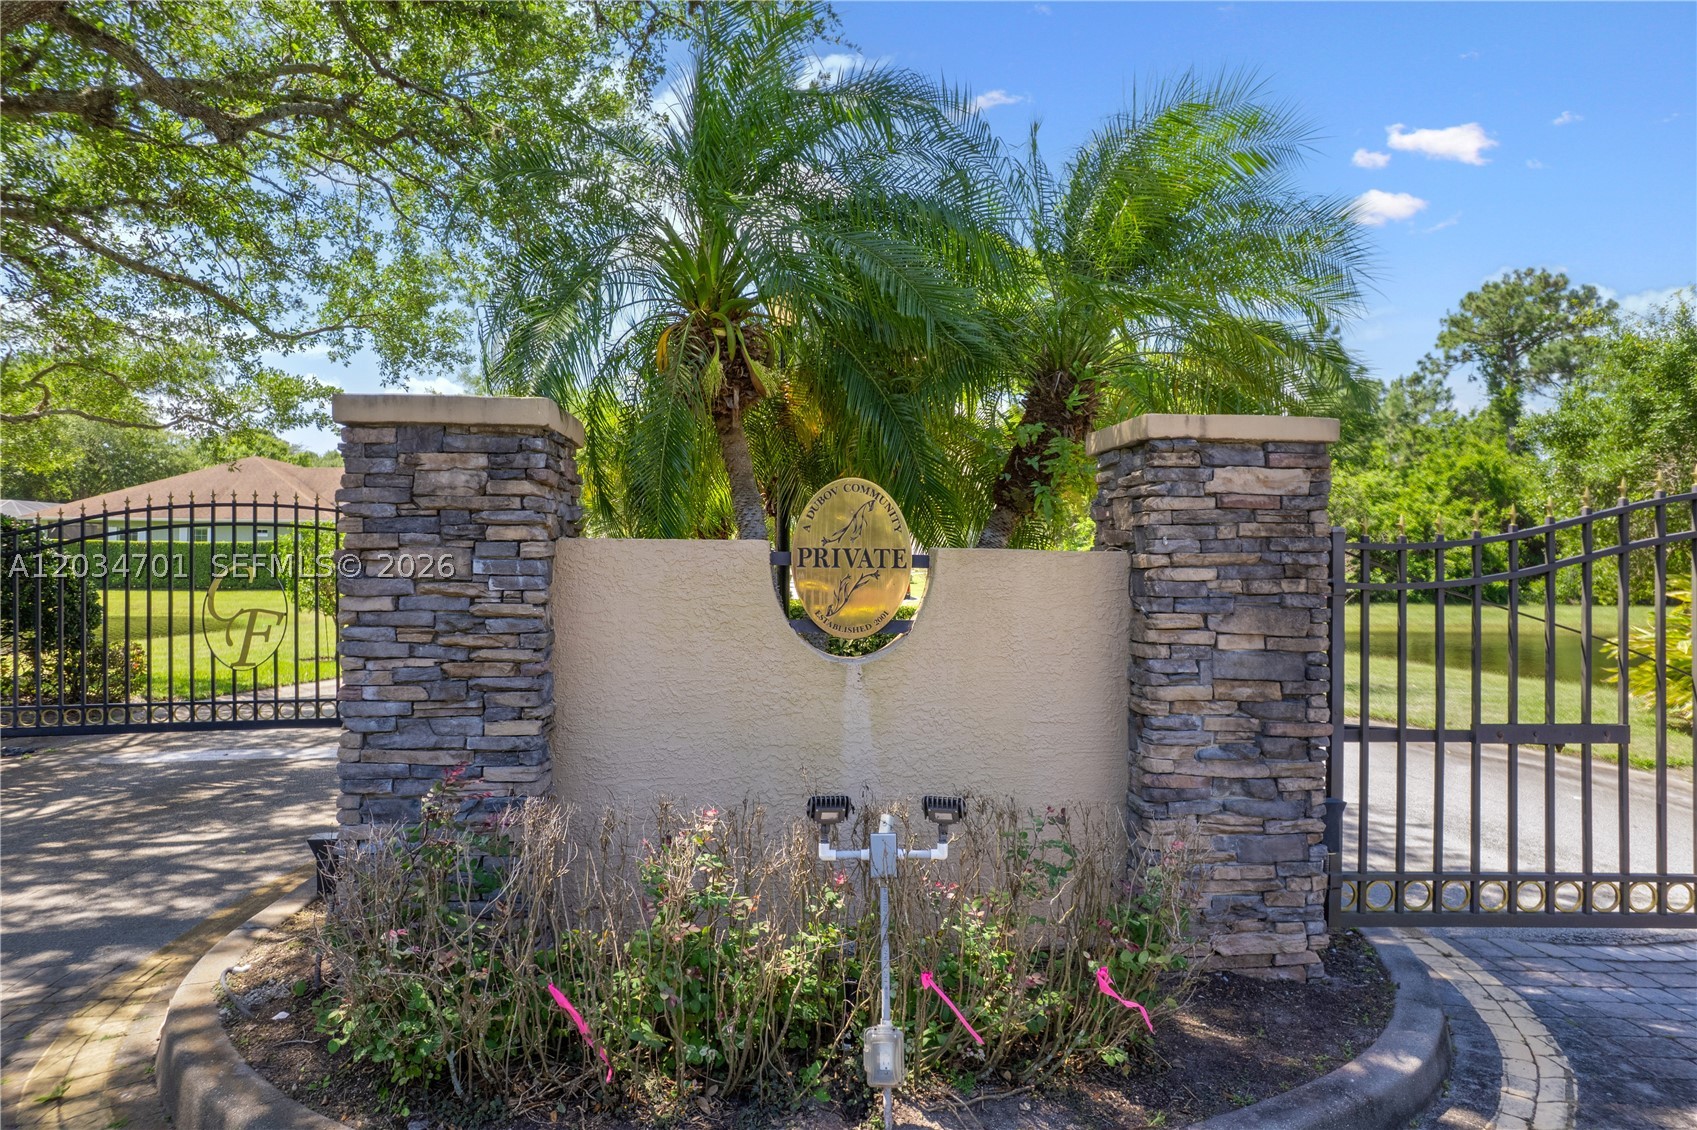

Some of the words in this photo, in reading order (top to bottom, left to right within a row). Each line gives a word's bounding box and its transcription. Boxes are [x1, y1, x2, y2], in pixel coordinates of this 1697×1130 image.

[806, 486, 838, 520] DUBOV
[843, 484, 902, 533] COMMUNITY
[803, 525, 811, 533] A
[797, 547, 907, 568] PRIVATE
[814, 609, 873, 633] ESTABLISHED
[873, 610, 889, 626] 2001
